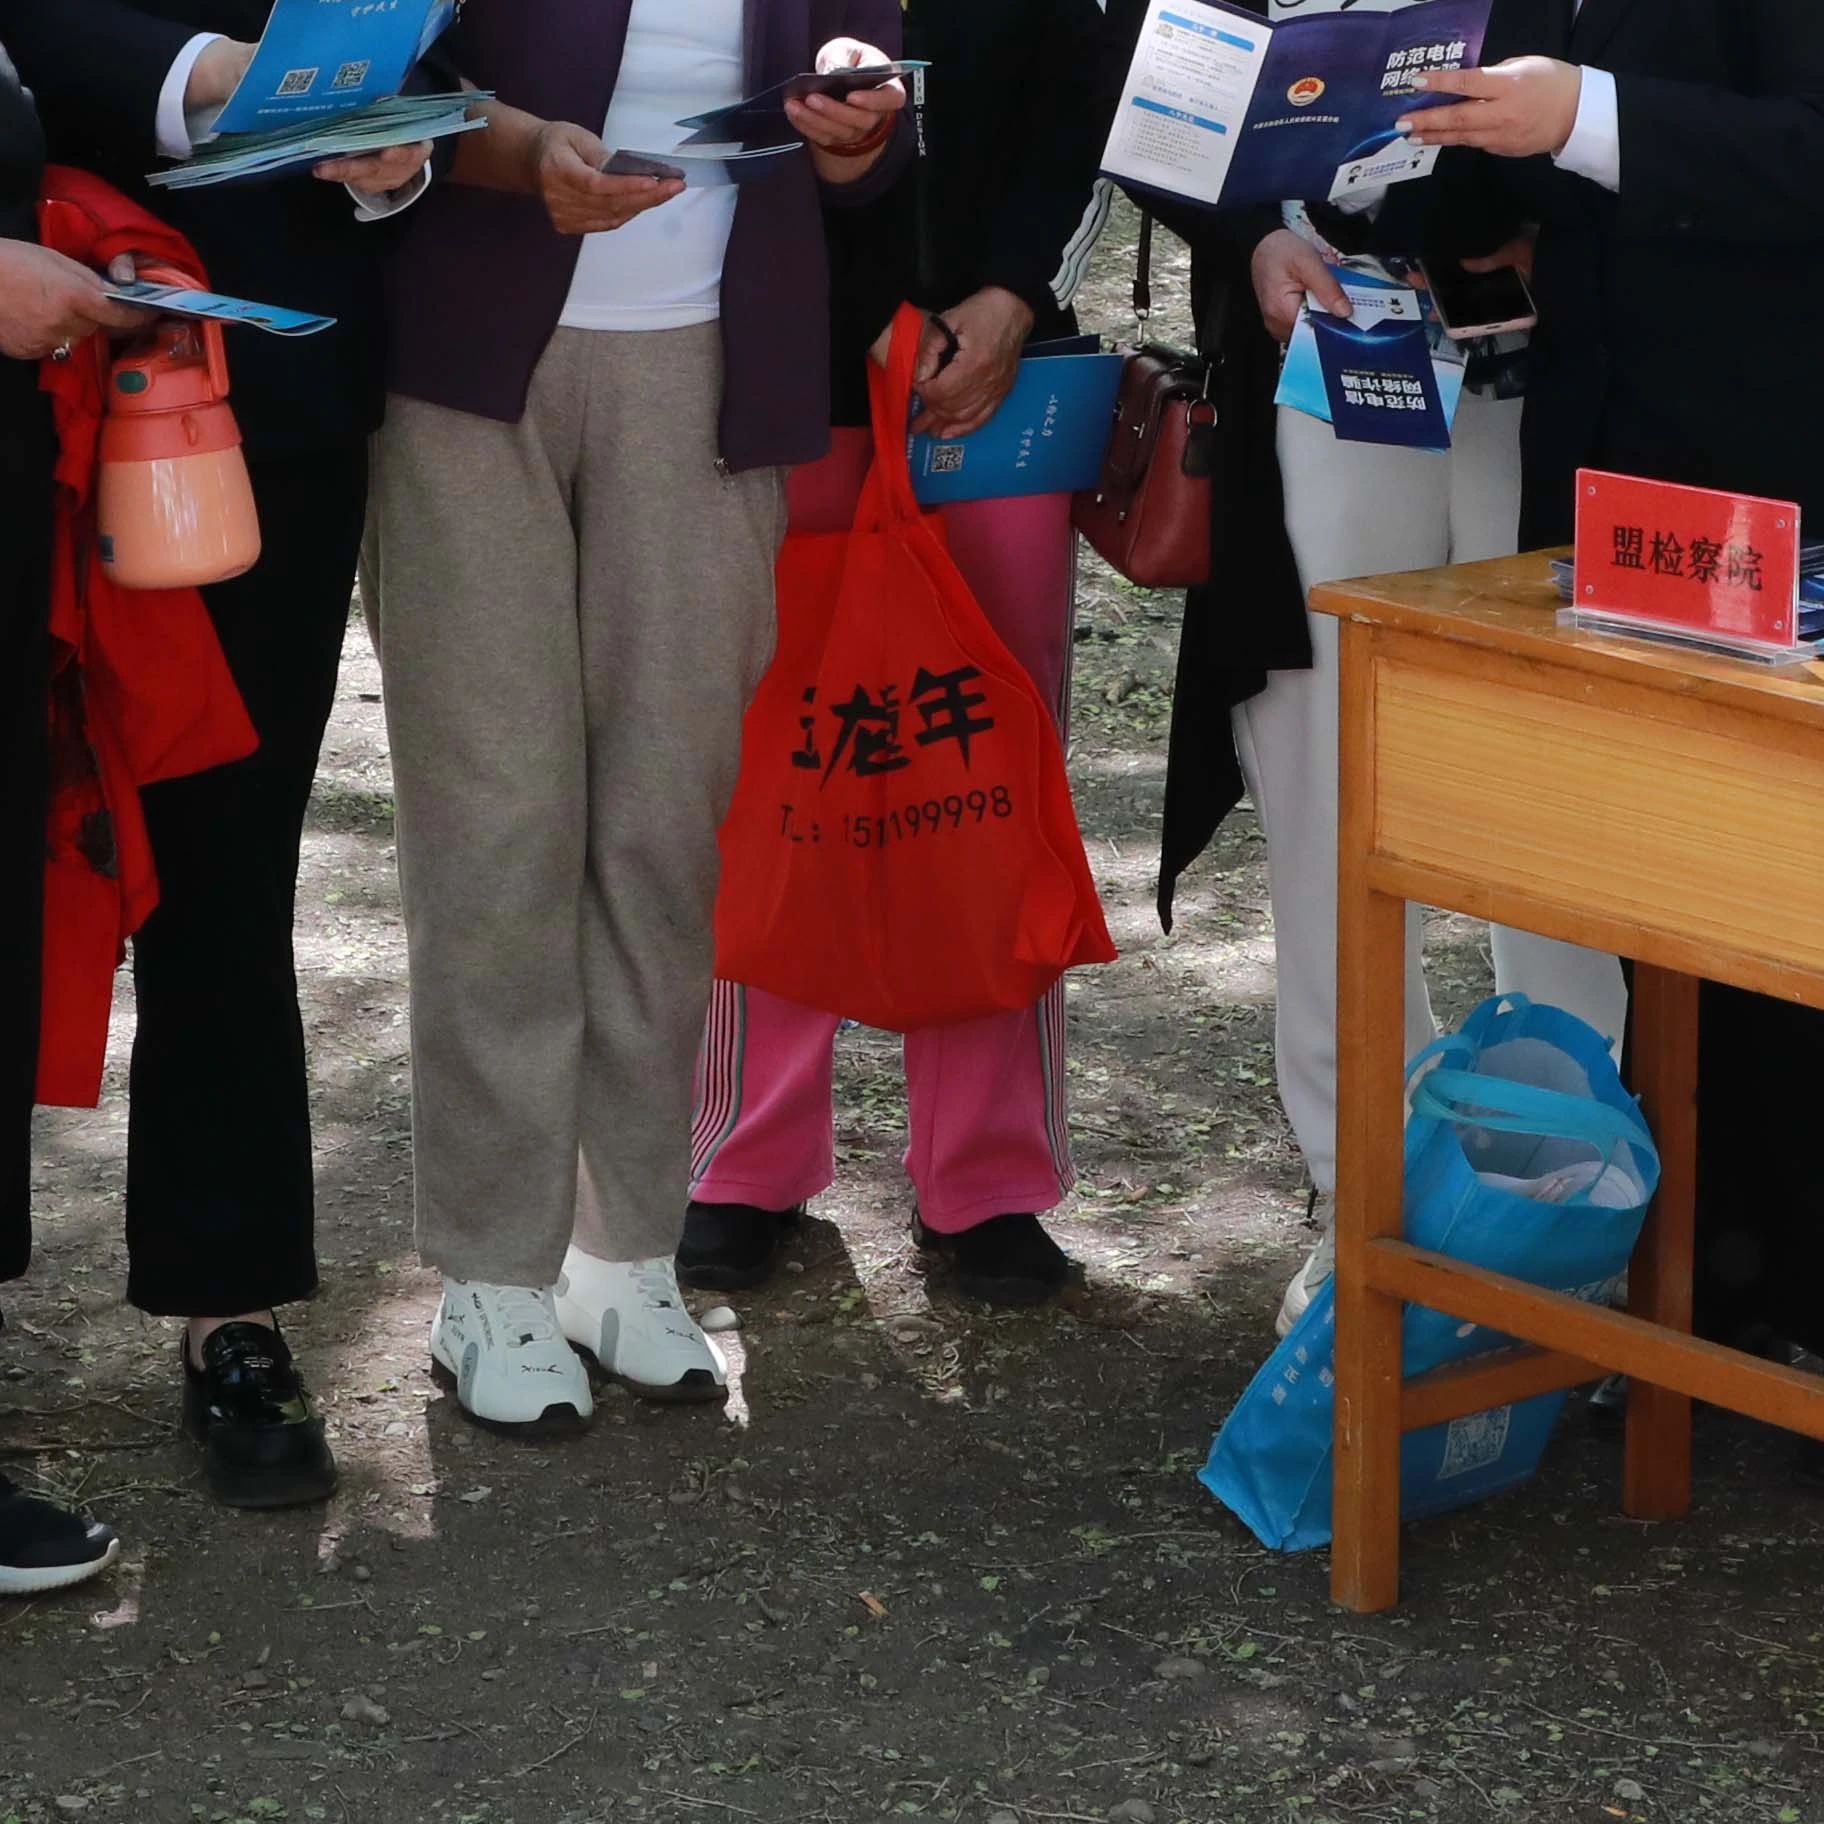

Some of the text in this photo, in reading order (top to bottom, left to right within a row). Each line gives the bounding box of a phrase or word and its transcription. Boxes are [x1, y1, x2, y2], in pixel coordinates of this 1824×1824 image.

[1386, 40, 1467, 70] 防范电信
[1344, 389, 1427, 411] 防范电信
[1610, 525, 1764, 592] 盟检察院
